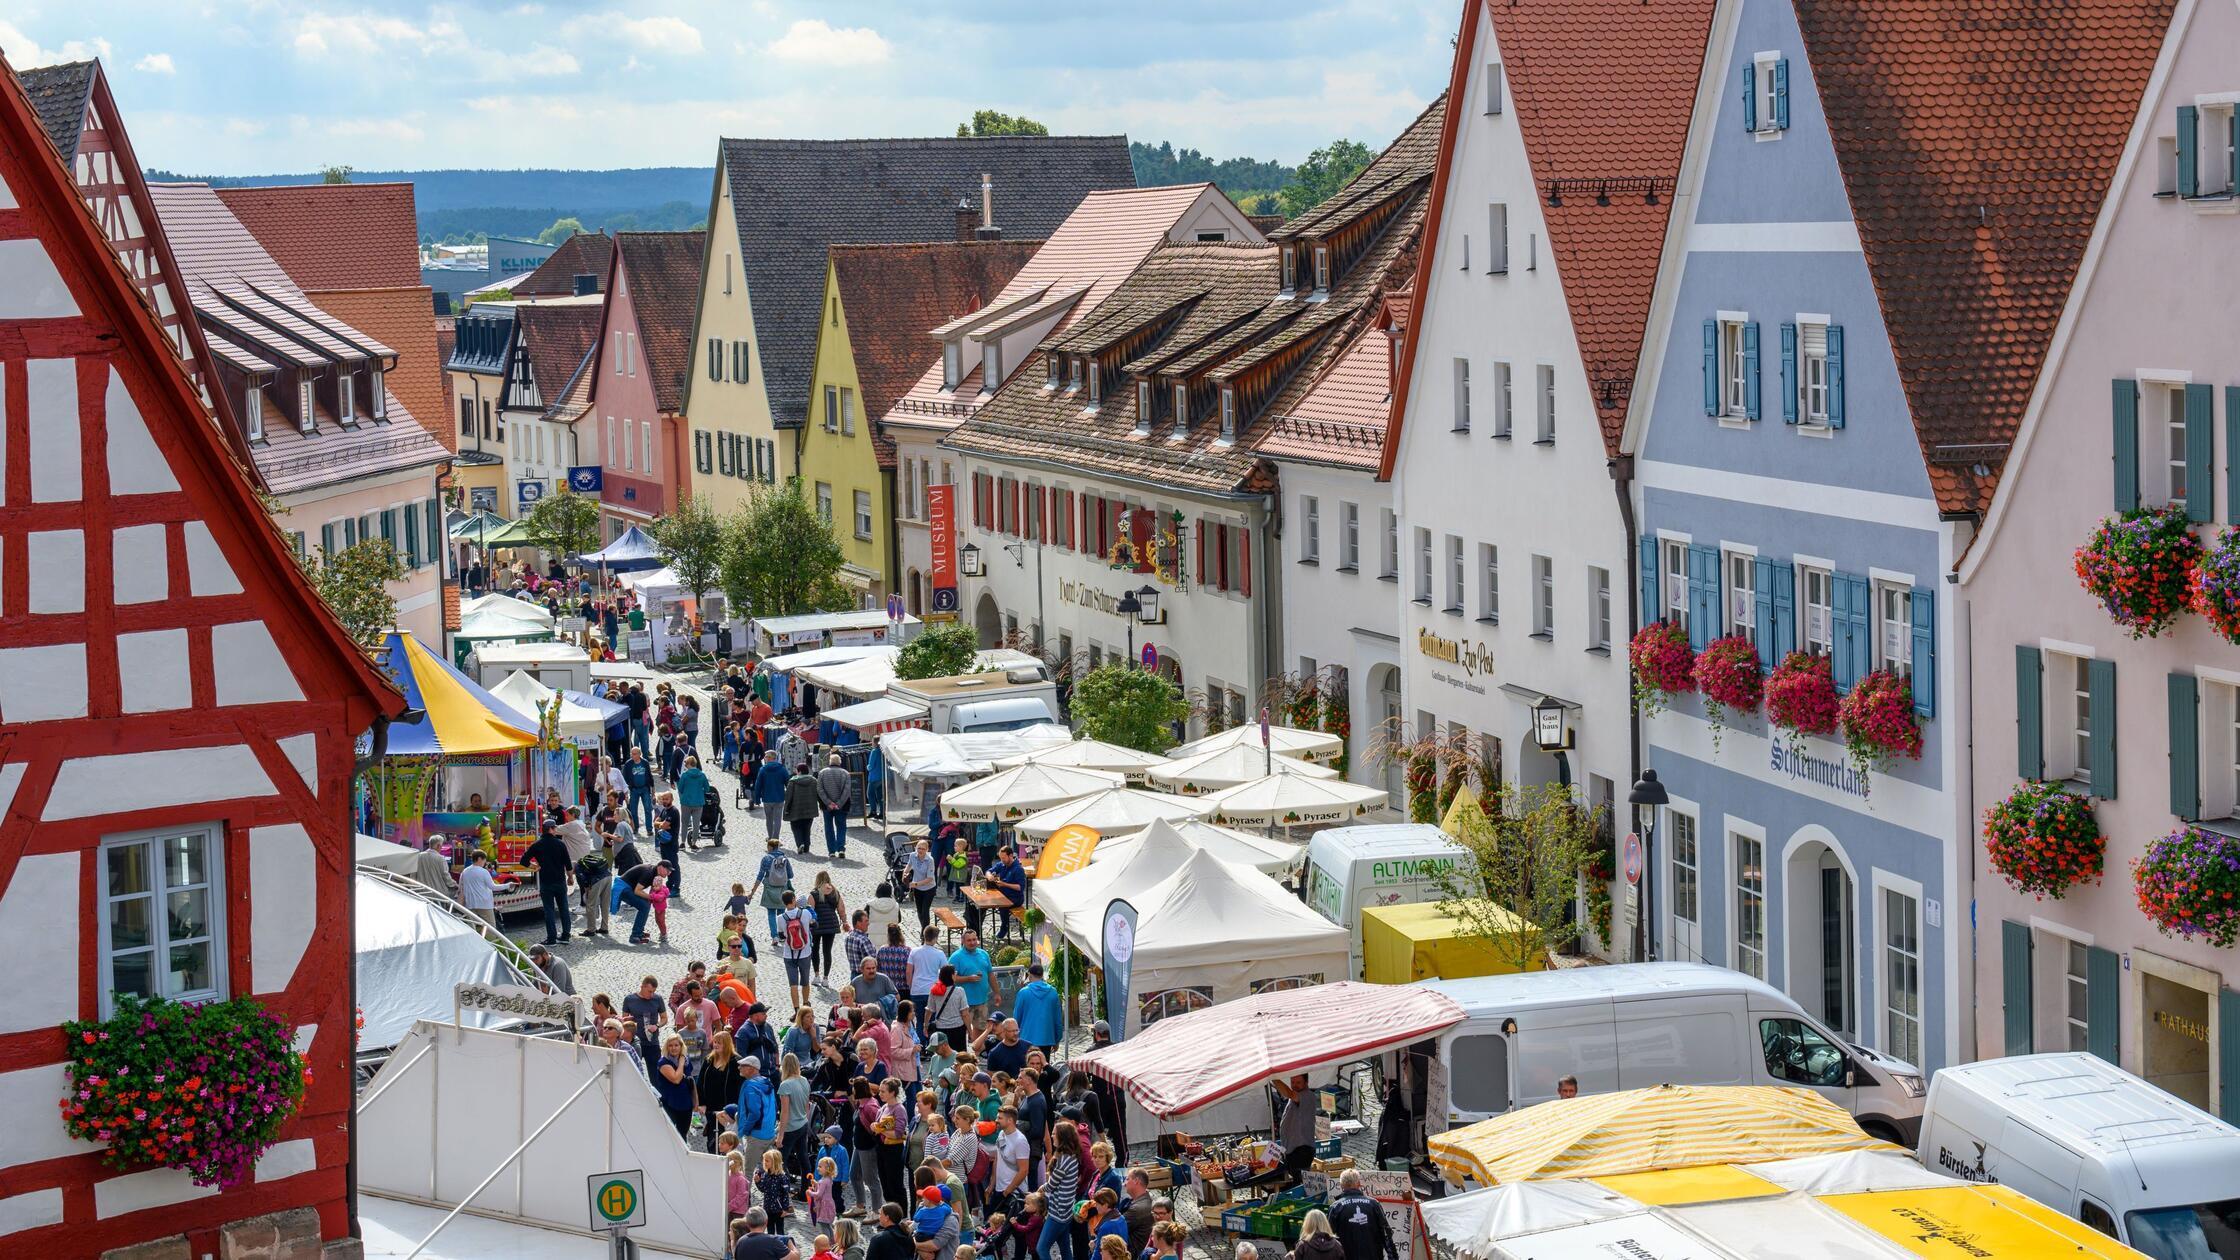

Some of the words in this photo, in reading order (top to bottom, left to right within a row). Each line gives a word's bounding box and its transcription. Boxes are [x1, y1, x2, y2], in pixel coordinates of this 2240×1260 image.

[930, 489, 947, 575] MUSEUM
[1462, 638, 1477, 677] Zur
[1477, 641, 1494, 675] Post
[1315, 750, 1338, 760] Pyraser
[1771, 736, 1869, 798] Schlemmerland
[1366, 802, 1386, 813] Pyraser
[961, 811, 990, 820] Pyraser
[1229, 816, 1265, 826] Pyraser
[1303, 811, 1342, 822] Pyraser
[1939, 1146, 1976, 1182] Bürsten
[1361, 1171, 1409, 1188] wetschge
